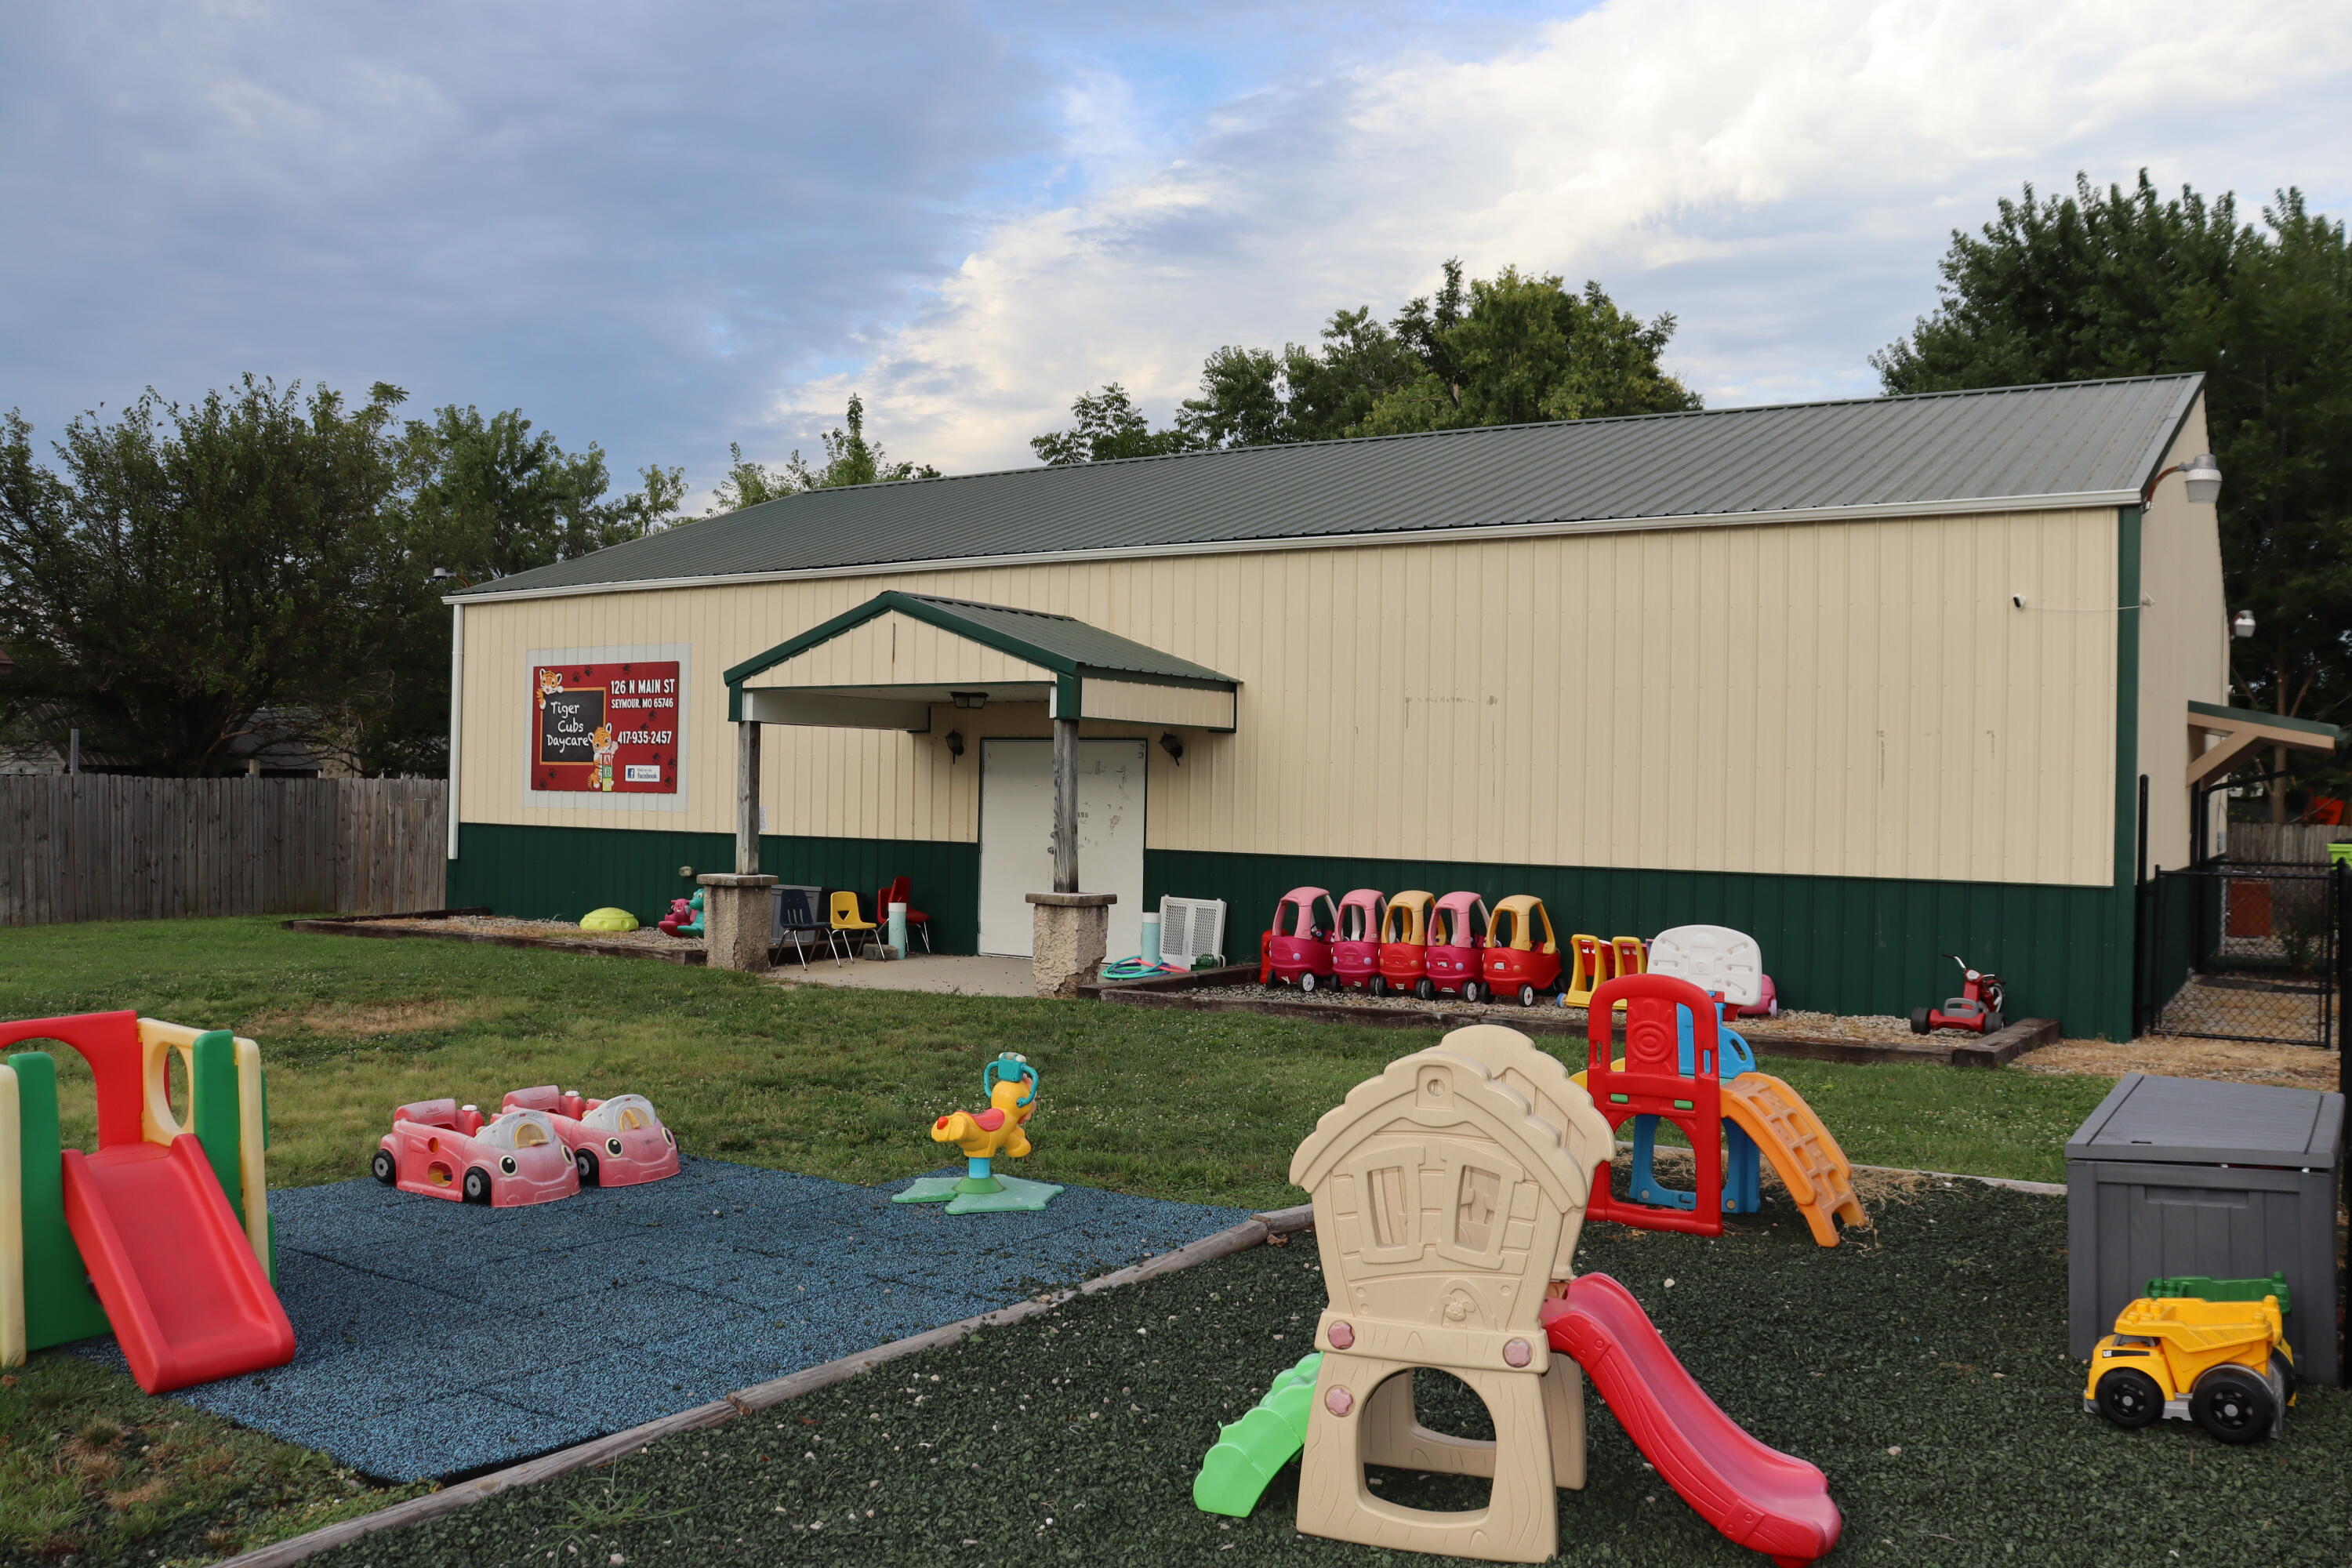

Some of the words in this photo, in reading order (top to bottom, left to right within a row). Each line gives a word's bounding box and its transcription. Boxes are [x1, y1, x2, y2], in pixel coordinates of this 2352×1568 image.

[611, 680, 626, 695] 126
[629, 680, 635, 694] N
[638, 679, 660, 694] MAIN
[663, 679, 675, 693] ST
[550, 701, 580, 719] Tiger
[643, 698, 652, 708] MO
[654, 698, 673, 708] 65746
[557, 717, 584, 733] Cubs
[546, 734, 590, 753] Daycare
